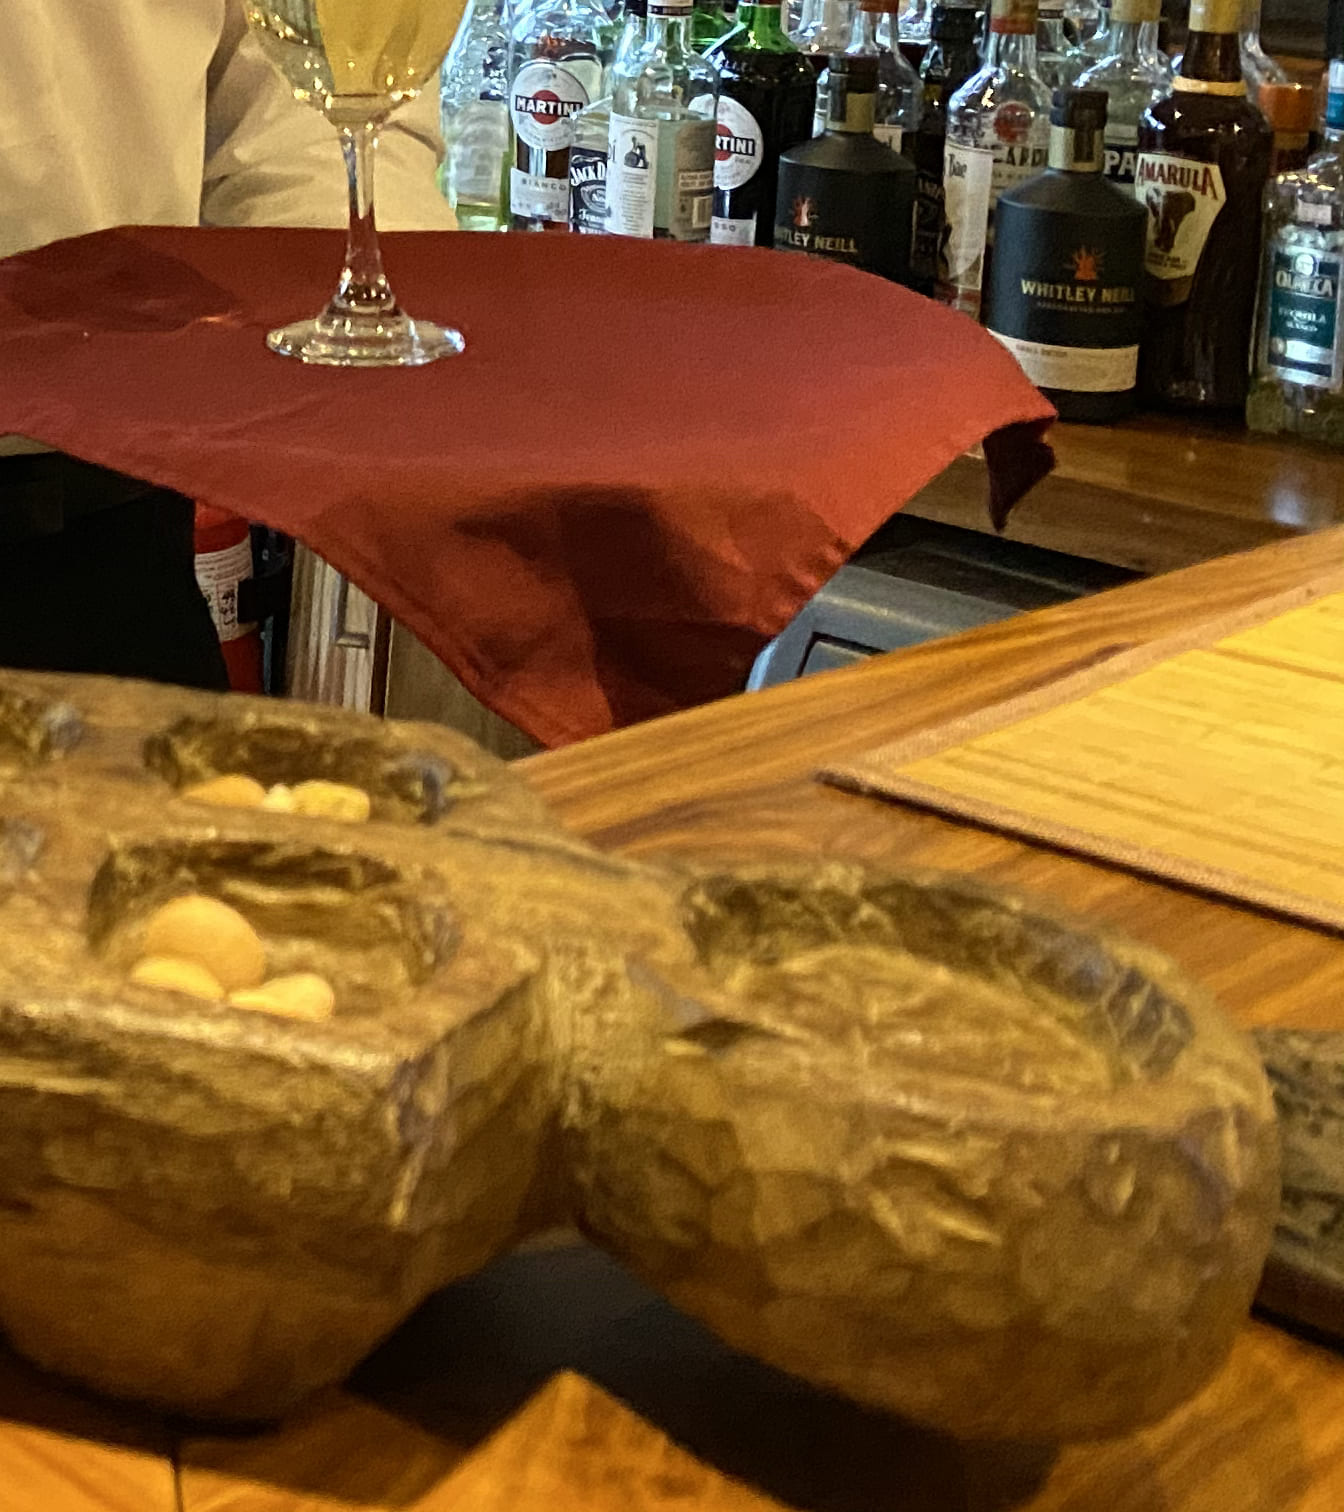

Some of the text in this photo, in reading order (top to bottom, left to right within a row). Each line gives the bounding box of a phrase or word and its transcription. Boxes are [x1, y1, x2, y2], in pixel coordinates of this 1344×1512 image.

[522, 177, 567, 191] BIANCO
[1136, 158, 1218, 201] AMARULA
[1021, 279, 1096, 302] WHITLEY
